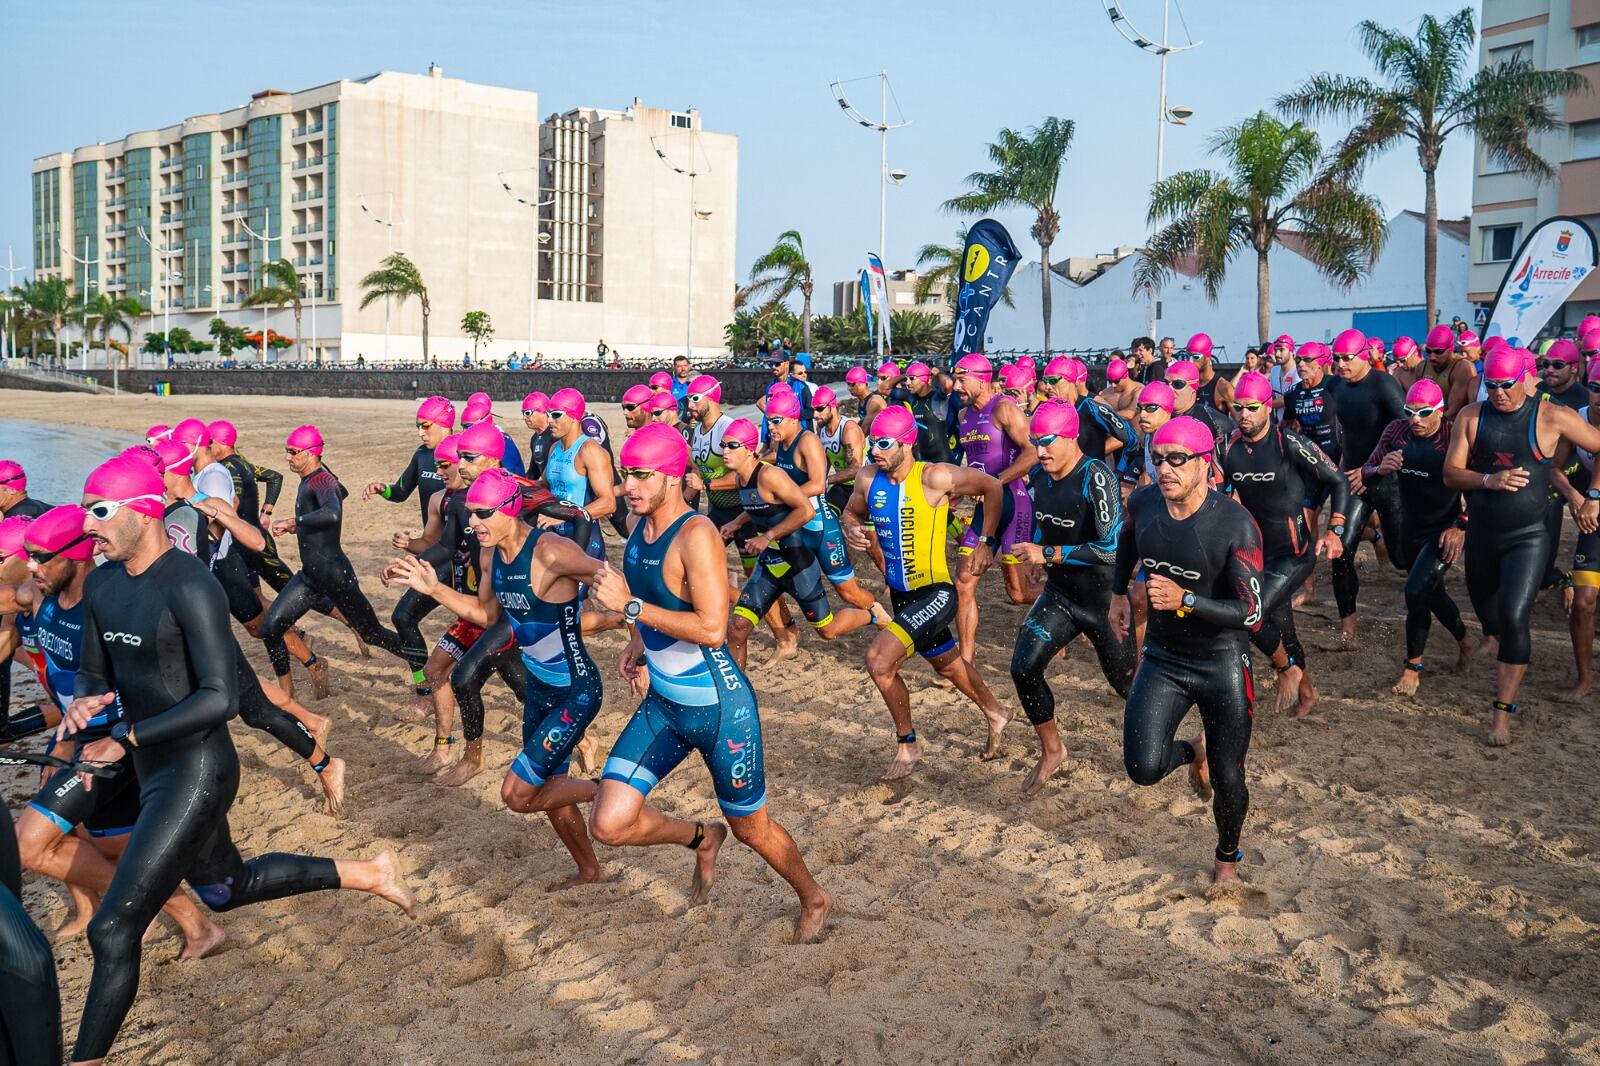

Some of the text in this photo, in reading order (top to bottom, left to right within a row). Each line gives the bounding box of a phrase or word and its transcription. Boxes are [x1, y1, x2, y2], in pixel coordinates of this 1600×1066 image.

[1532, 266, 1571, 281] Arrecife
[1098, 405, 1124, 429] orca
[1286, 434, 1318, 465] orca
[1232, 472, 1275, 482] orca
[1400, 468, 1429, 478] orca
[1095, 472, 1111, 522] orca
[1035, 511, 1076, 528] orca
[900, 507, 916, 576] CICLOTEAM
[1143, 558, 1201, 580] orca
[912, 590, 950, 626] CICLOTEAM
[103, 631, 142, 647] orca
[564, 606, 588, 677] C.N. REALES
[709, 647, 742, 691] EALES
